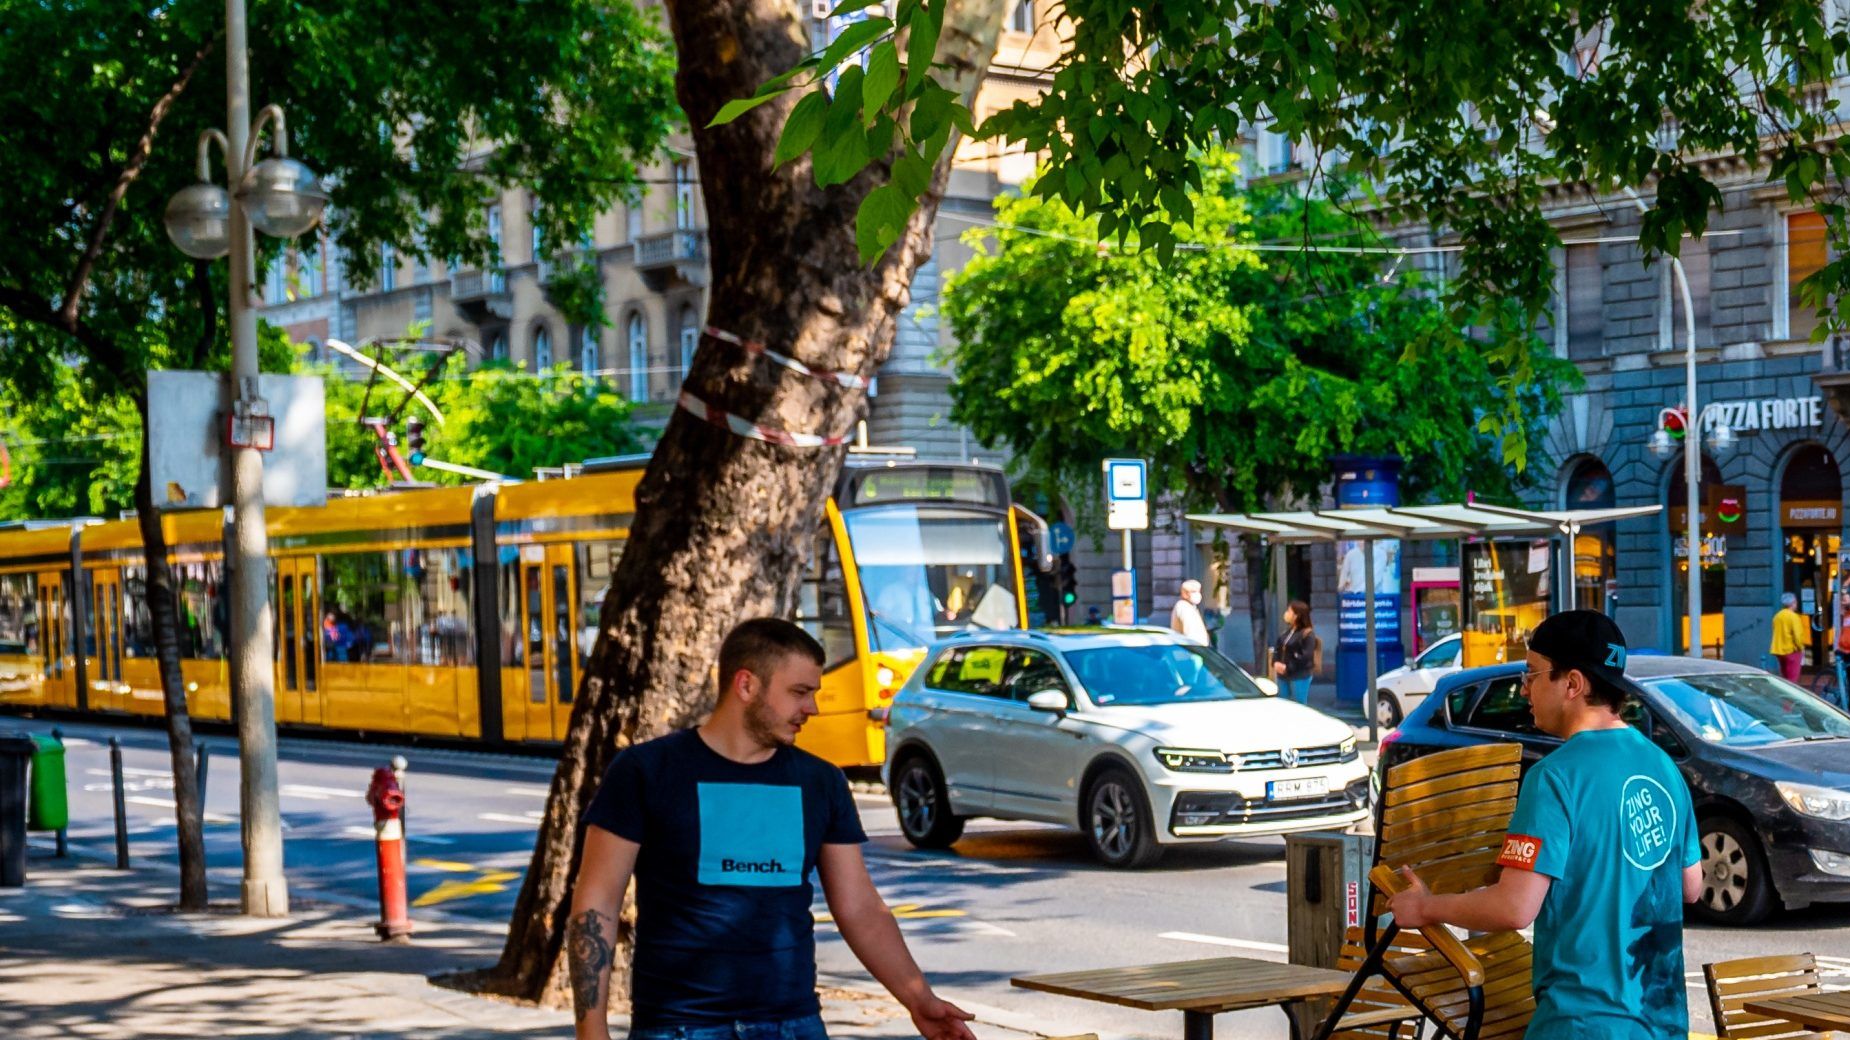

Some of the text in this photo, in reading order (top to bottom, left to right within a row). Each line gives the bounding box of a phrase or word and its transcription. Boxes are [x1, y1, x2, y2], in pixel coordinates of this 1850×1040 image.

[1761, 397, 1823, 430] FORTE
[1626, 787, 1653, 819] ZING
[1629, 806, 1663, 838] YOUR
[1503, 839, 1535, 858] ZING
[1635, 825, 1667, 858] LIFE!
[721, 858, 786, 873] Bench.
